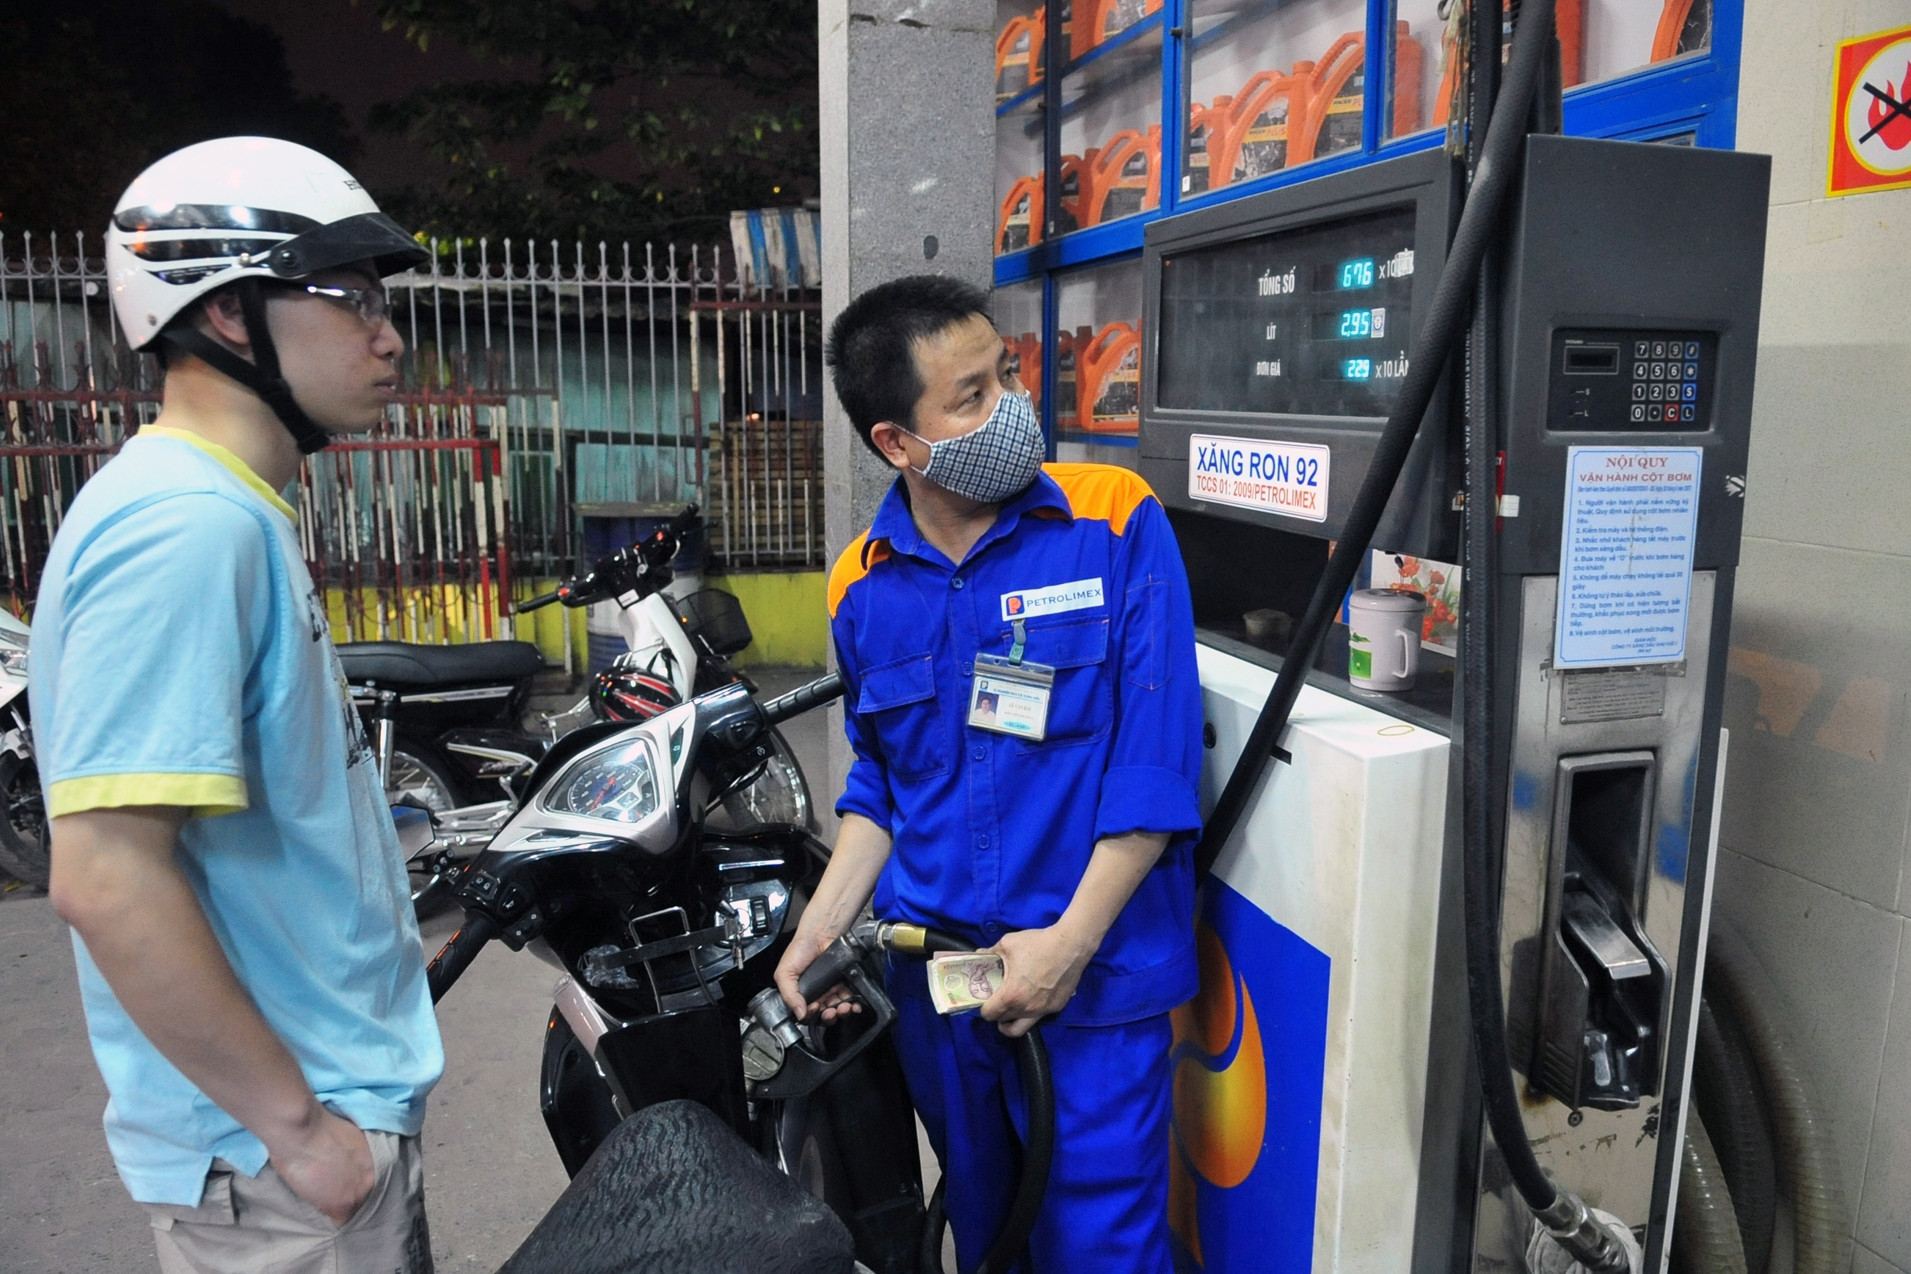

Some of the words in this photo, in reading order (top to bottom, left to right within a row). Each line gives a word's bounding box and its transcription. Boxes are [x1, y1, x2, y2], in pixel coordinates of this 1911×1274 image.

[1259, 268, 1280, 296] TỔNG
[1282, 265, 1296, 294] SỐ
[1342, 261, 1372, 288] 676
[1639, 344, 1646, 355] 7
[1655, 345, 1662, 355] 8
[1672, 345, 1679, 355] 9
[1347, 359, 1370, 378] 229
[1637, 366, 1644, 376] 4
[1654, 366, 1661, 376] 5
[1671, 366, 1677, 376] 6
[1637, 387, 1642, 397] 1
[1653, 387, 1659, 397] 2
[1669, 387, 1676, 397] 3
[1634, 408, 1641, 418] 0
[1668, 408, 1675, 418] C
[1685, 408, 1691, 417] L
[1197, 442, 1244, 476] XĂNG
[1249, 452, 1289, 483] RON
[1296, 457, 1318, 487] 92
[1606, 455, 1633, 470] NỘI
[1637, 457, 1668, 469] QUY
[1197, 475, 1217, 493] TCCS
[1580, 472, 1603, 484] VẬN
[1606, 472, 1638, 482] HÀNH
[1641, 472, 1664, 483] CỘT
[1667, 473, 1692, 482] BƠM
[1026, 588, 1101, 607] PETROLIMEX
